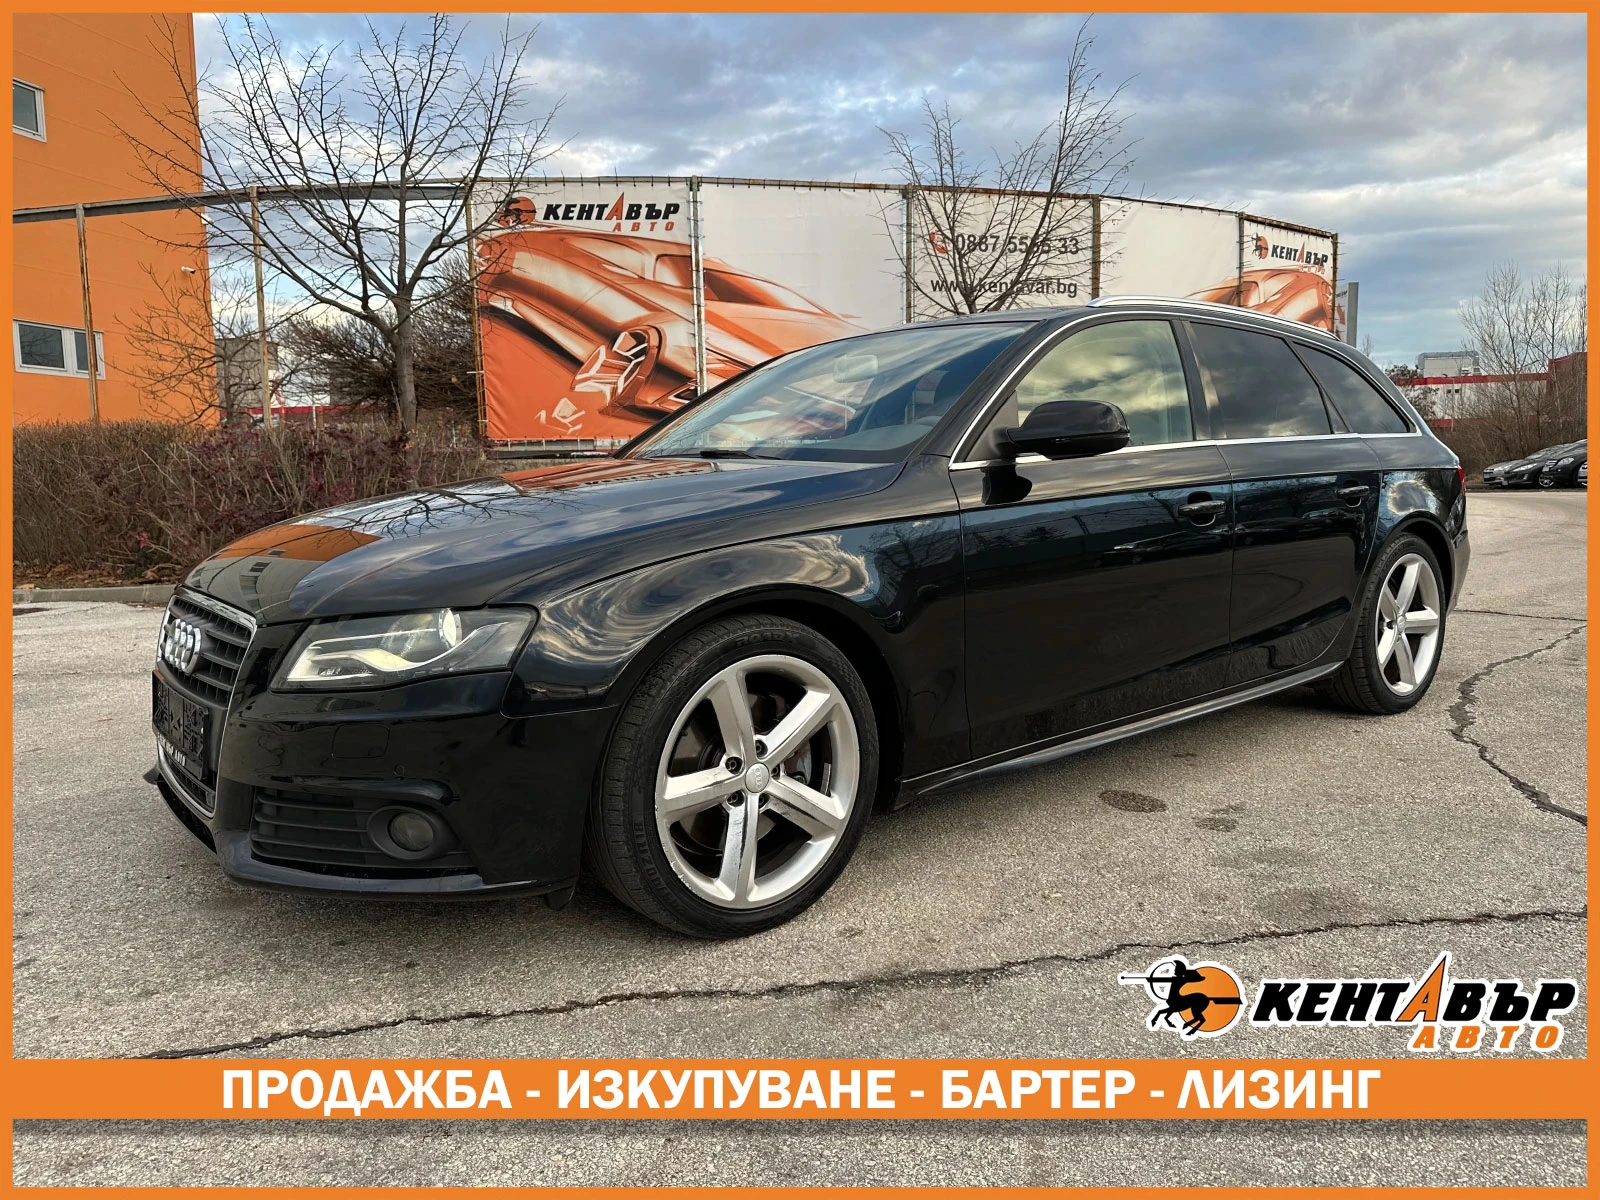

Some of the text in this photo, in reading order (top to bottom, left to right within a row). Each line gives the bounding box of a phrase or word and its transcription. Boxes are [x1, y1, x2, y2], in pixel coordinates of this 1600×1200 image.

[542, 191, 681, 221] КЕНТАВЪР
[612, 221, 675, 232] АВТО
[955, 233, 1000, 253] 0887
[1058, 237, 1080, 255] 33
[1270, 240, 1329, 267] КЕНТАВЪР
